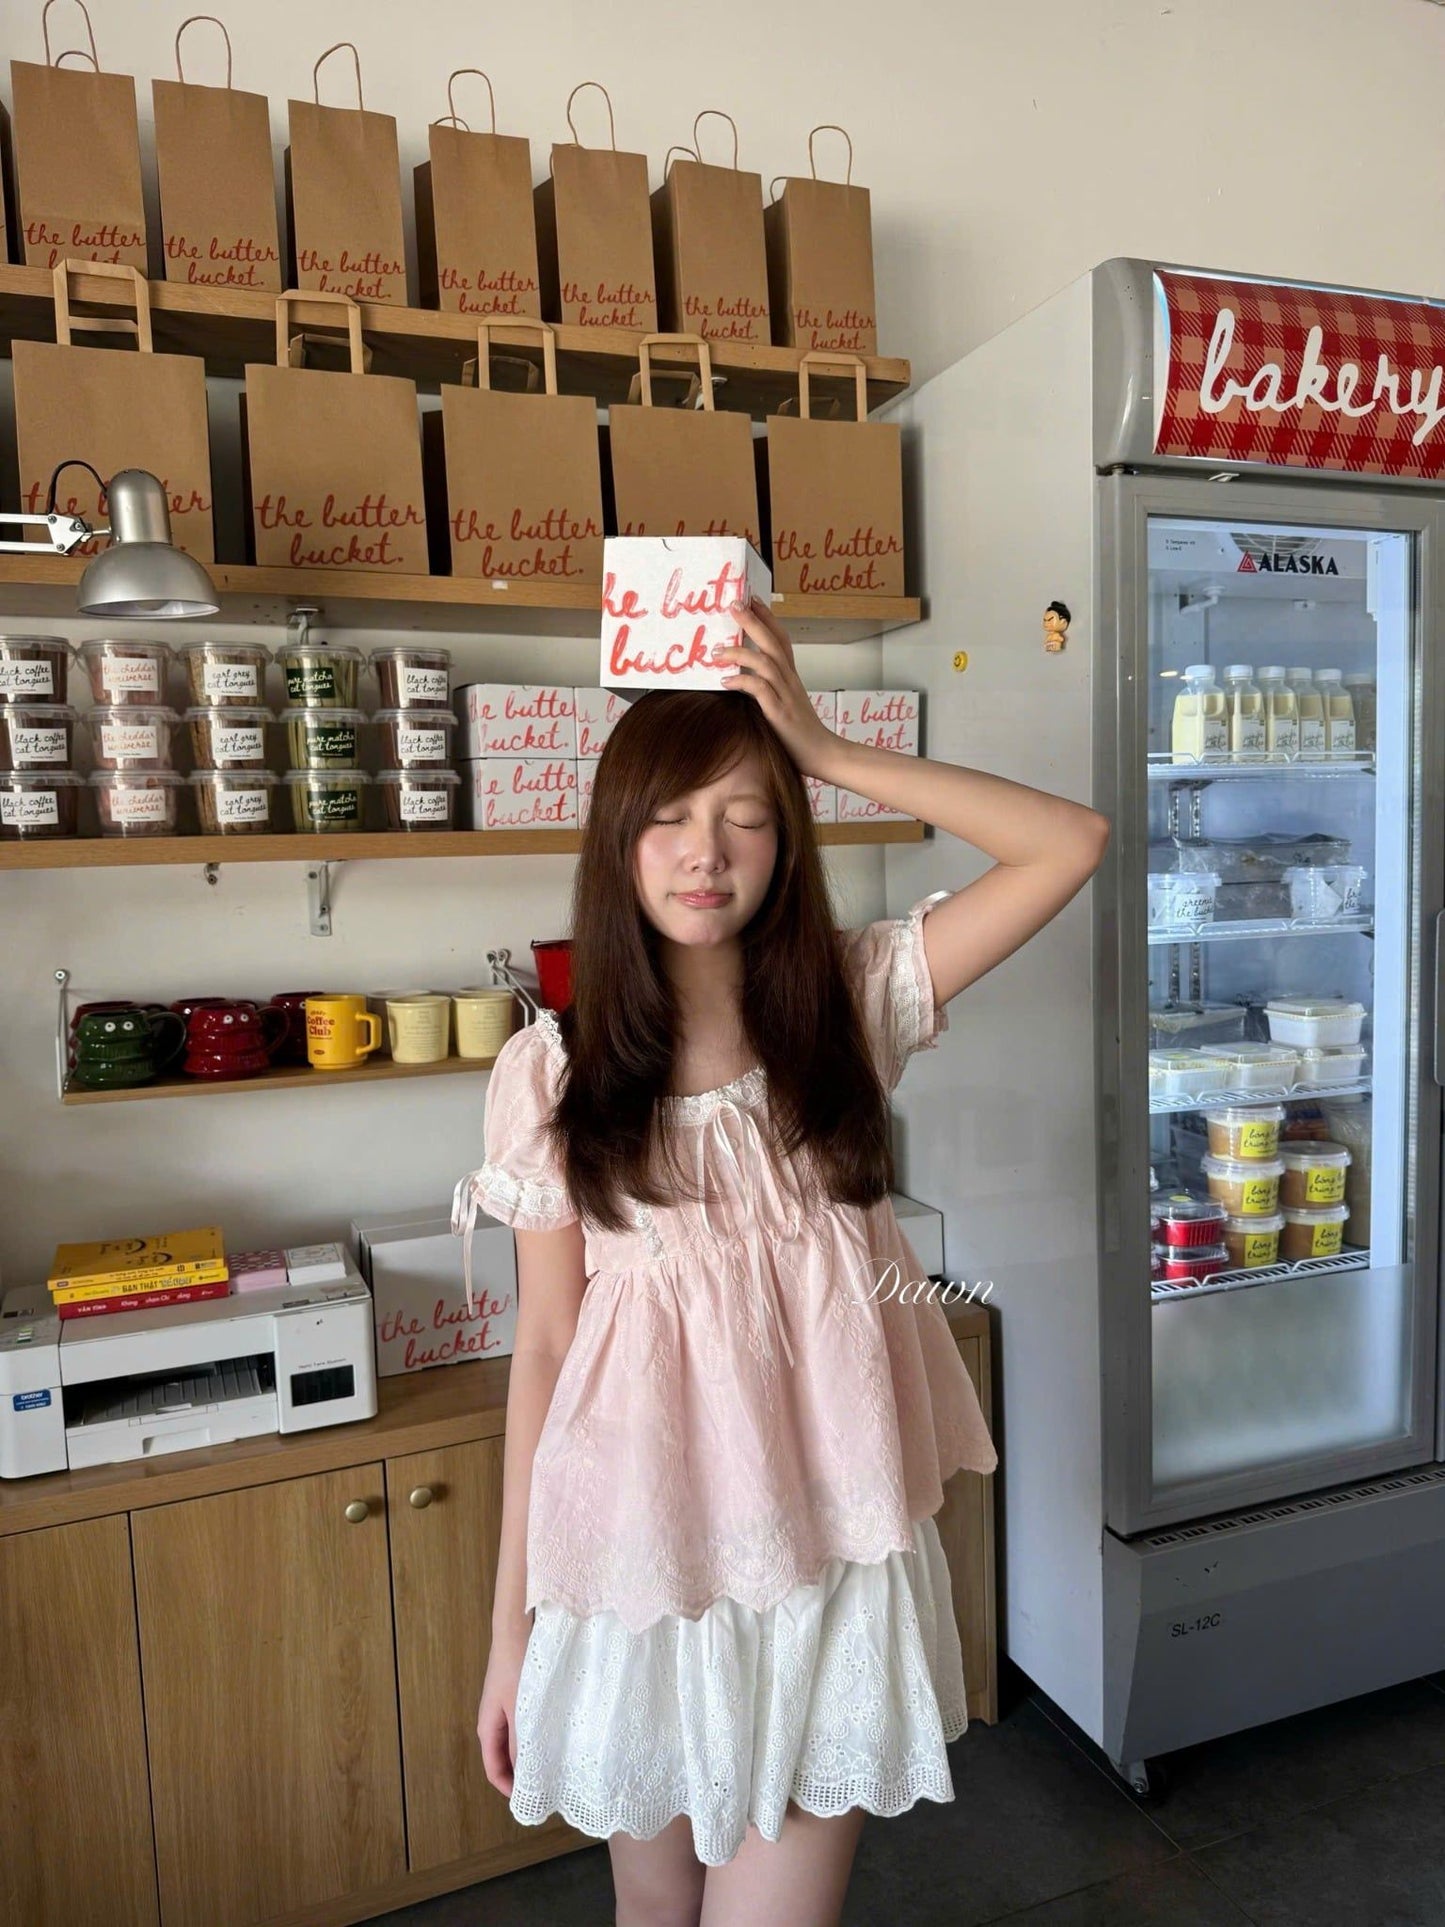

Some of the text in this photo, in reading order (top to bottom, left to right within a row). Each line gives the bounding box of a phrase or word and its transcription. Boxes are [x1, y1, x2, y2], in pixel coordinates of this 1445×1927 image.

[24, 222, 145, 248] the butter
[164, 236, 279, 262] the butter
[188, 262, 265, 286] bucket.
[298, 250, 405, 275] the butter
[439, 268, 538, 292] the butter
[459, 292, 526, 315] bucket.
[561, 283, 656, 305] the butter
[684, 296, 770, 318] the butter
[579, 307, 643, 327] bucket.
[701, 317, 759, 340] bucket.
[794, 309, 876, 330] the butter
[811, 330, 866, 350] bucket.
[1199, 308, 1445, 447] bakery
[254, 493, 313, 530] the
[323, 494, 424, 530] butter
[450, 509, 504, 543] the
[511, 508, 603, 543] butter
[290, 532, 403, 567] bucket.
[774, 529, 818, 563] the
[824, 527, 905, 559] butter
[482, 546, 584, 579] bucket.
[1258, 552, 1339, 576] ALASKA
[799, 559, 886, 594] bucket.
[512, 762, 577, 794] butte
[486, 793, 576, 827] bucket.
[377, 1309, 425, 1342] the
[404, 1321, 500, 1369] bucket.
[1171, 1613, 1221, 1638] SL-12C
